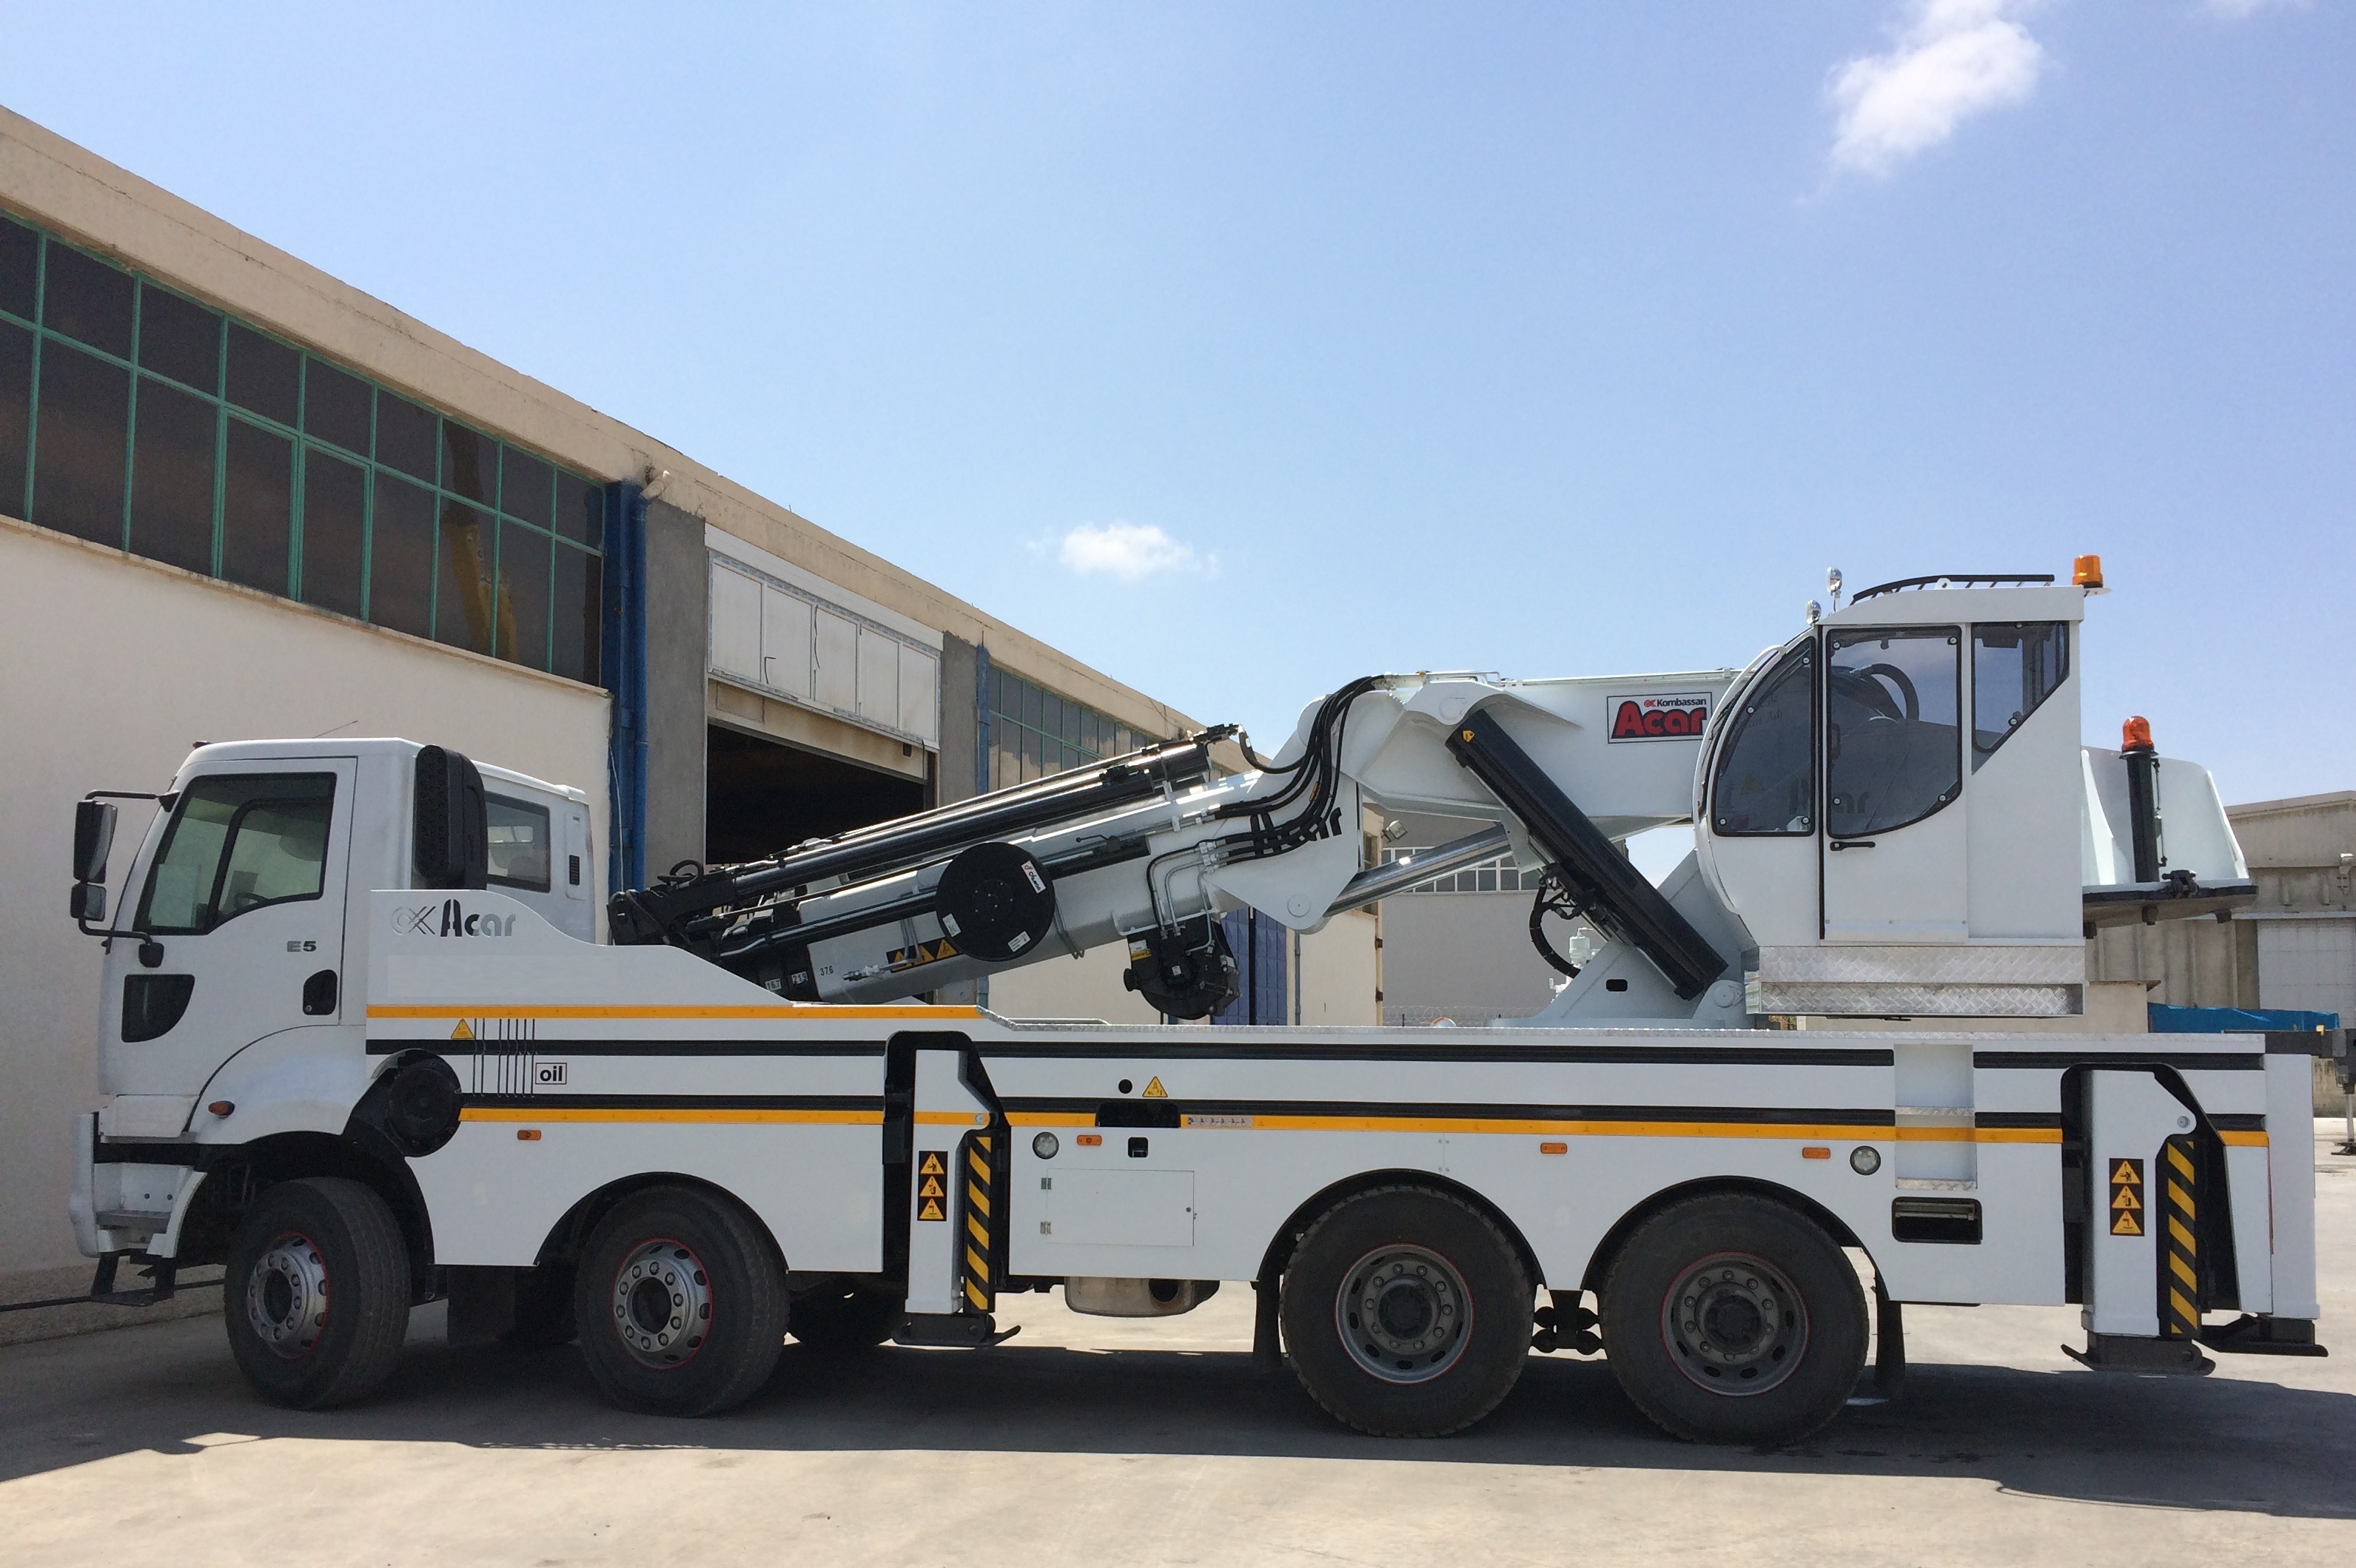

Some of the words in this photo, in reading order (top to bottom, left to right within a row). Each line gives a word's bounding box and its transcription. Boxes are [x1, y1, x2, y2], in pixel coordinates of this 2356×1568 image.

[1657, 698, 1707, 707] Kombassan
[1611, 700, 1707, 738] Acar
[440, 898, 516, 937] Acar
[286, 941, 317, 952] E5
[540, 1066, 563, 1082] oil
